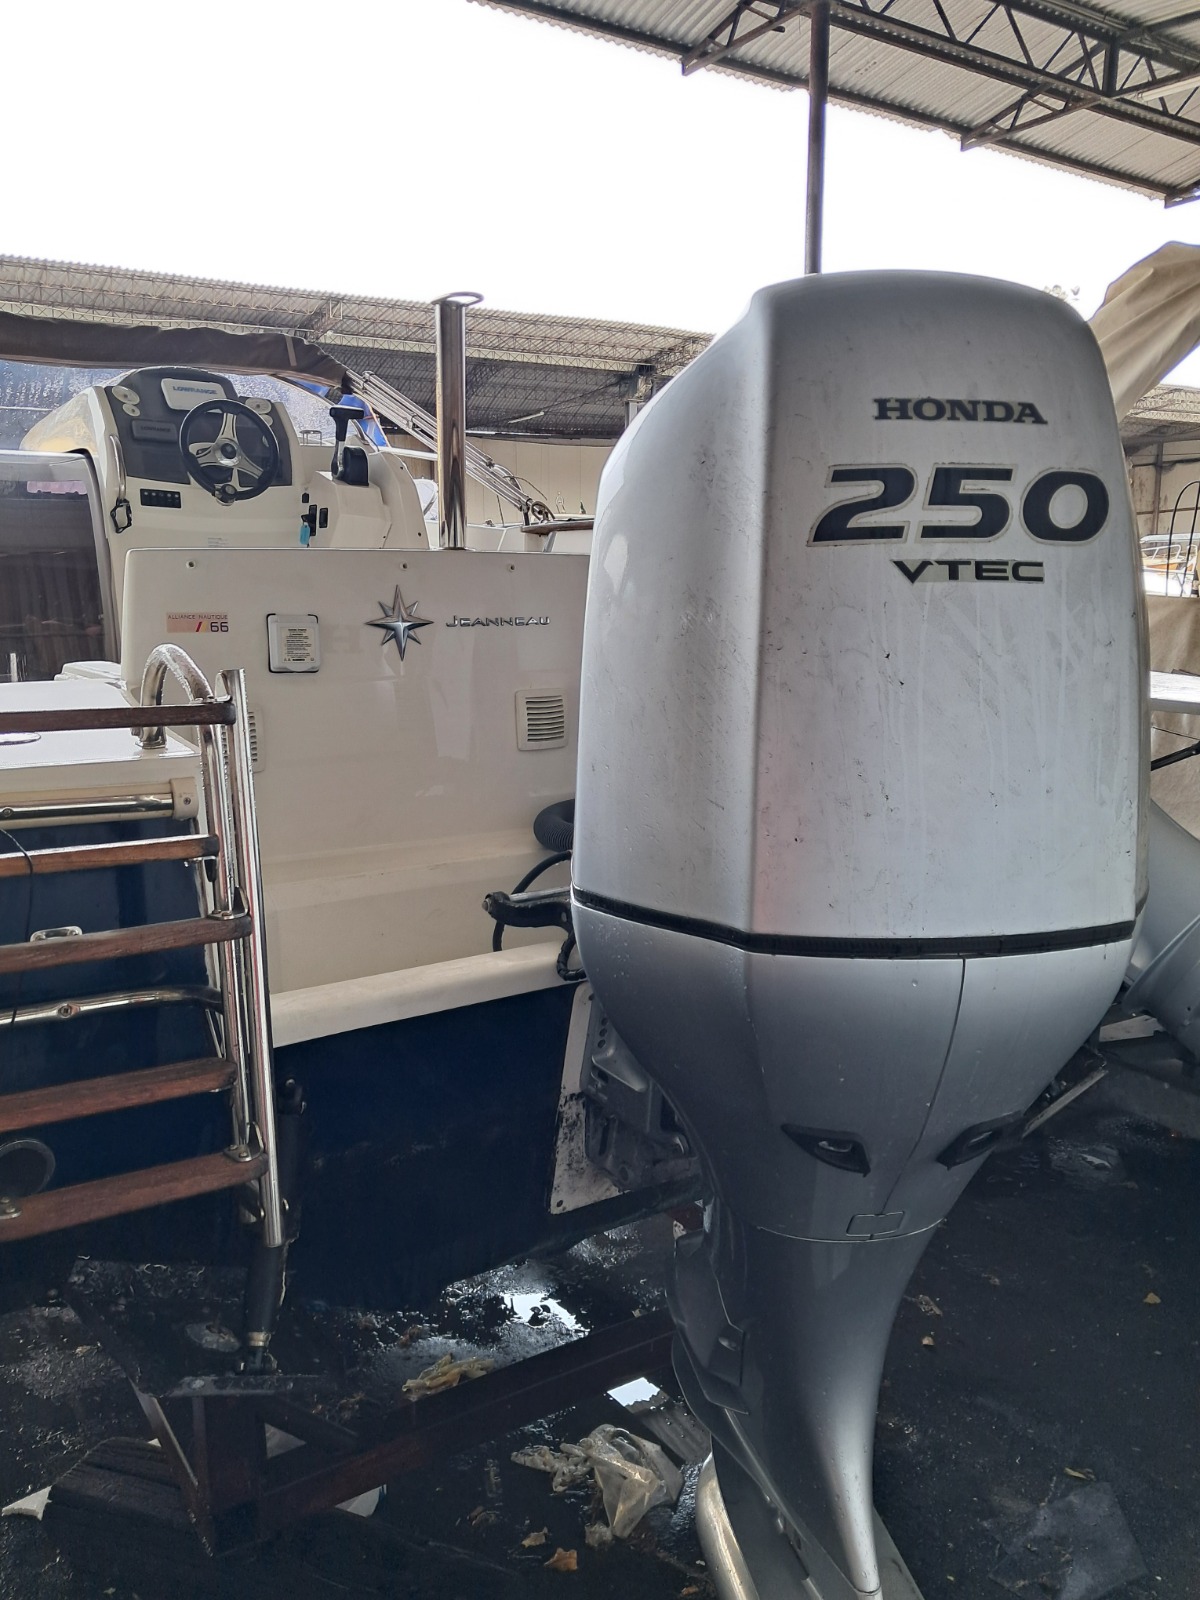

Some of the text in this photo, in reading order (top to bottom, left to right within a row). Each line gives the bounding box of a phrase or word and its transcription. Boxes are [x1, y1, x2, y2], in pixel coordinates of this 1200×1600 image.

[873, 397, 1048, 424] HONDA
[808, 464, 1111, 544] 250
[891, 559, 1045, 584] VTEC
[210, 621, 229, 633] 66
[446, 615, 550, 628] JEANNEAU
